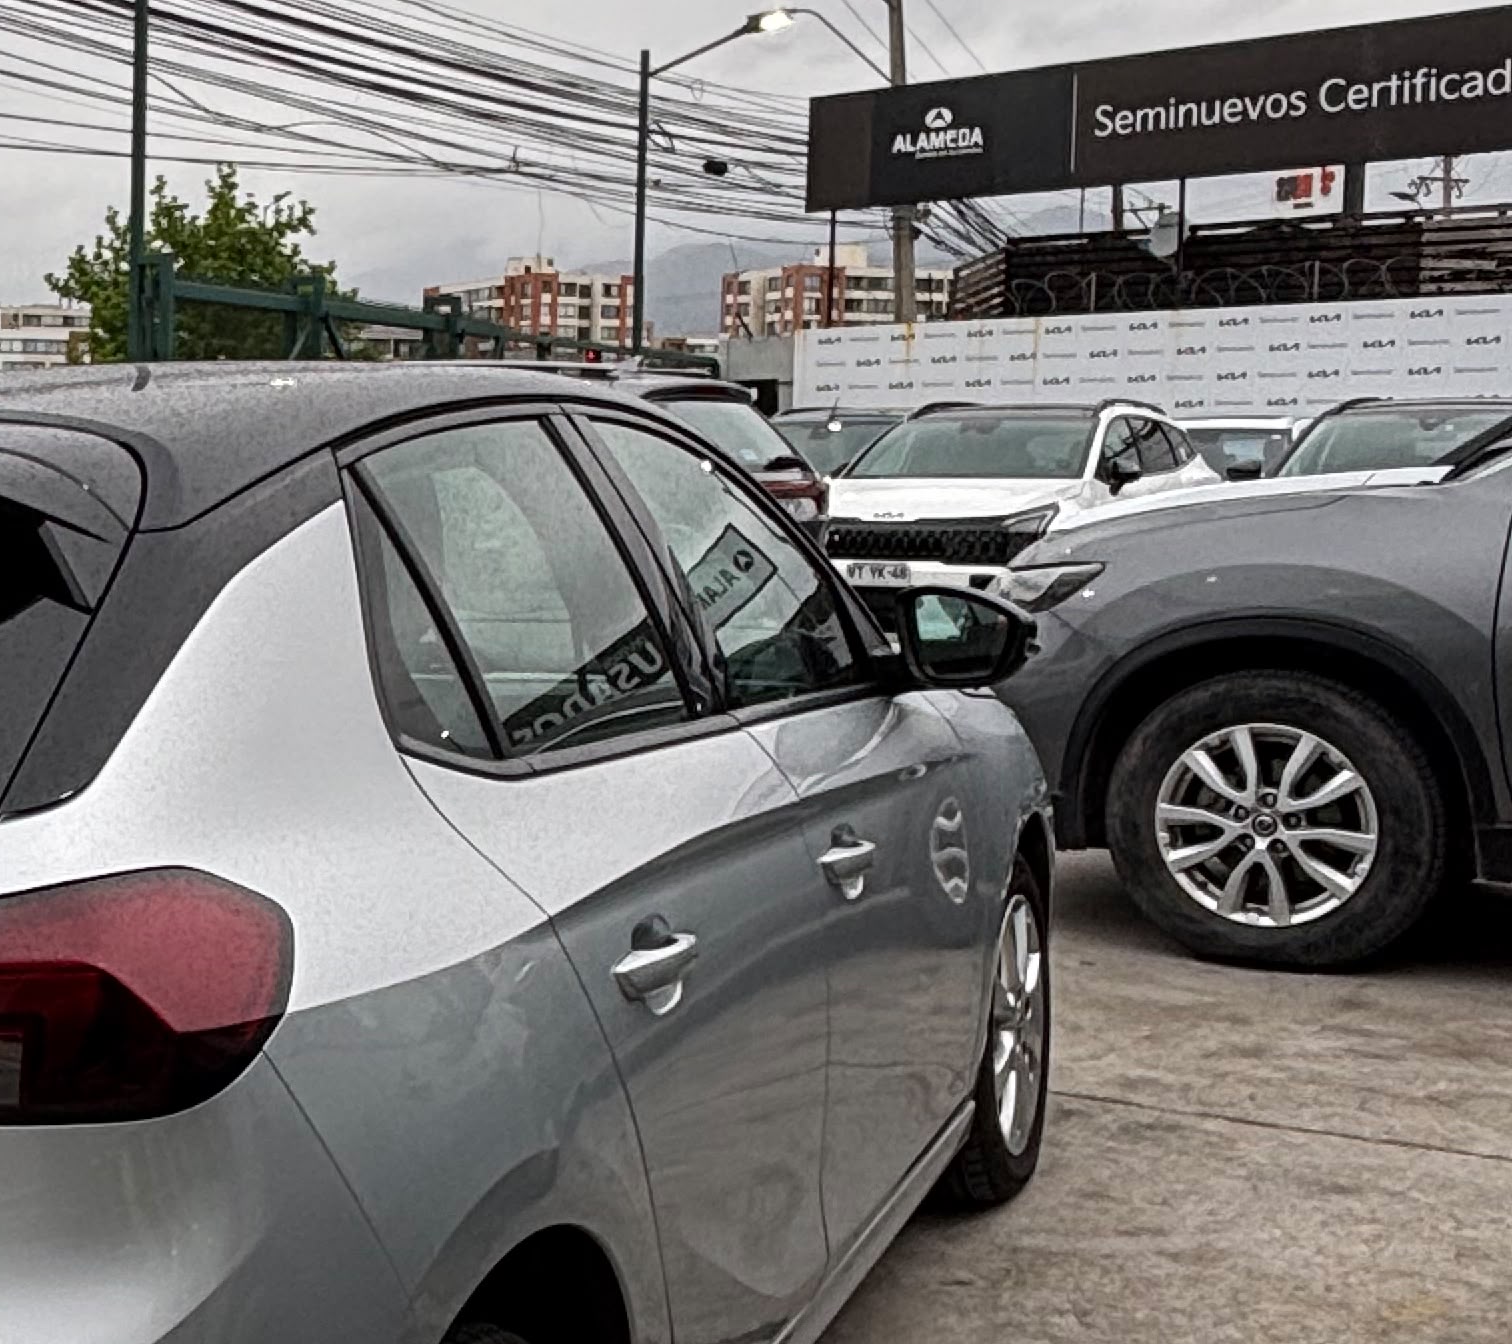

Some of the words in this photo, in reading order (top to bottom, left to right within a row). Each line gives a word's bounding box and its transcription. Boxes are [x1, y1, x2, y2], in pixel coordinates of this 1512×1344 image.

[1093, 88, 1307, 138] Seminuevos
[1319, 58, 1512, 113] Certificad
[891, 127, 984, 154] ALAMEDA
